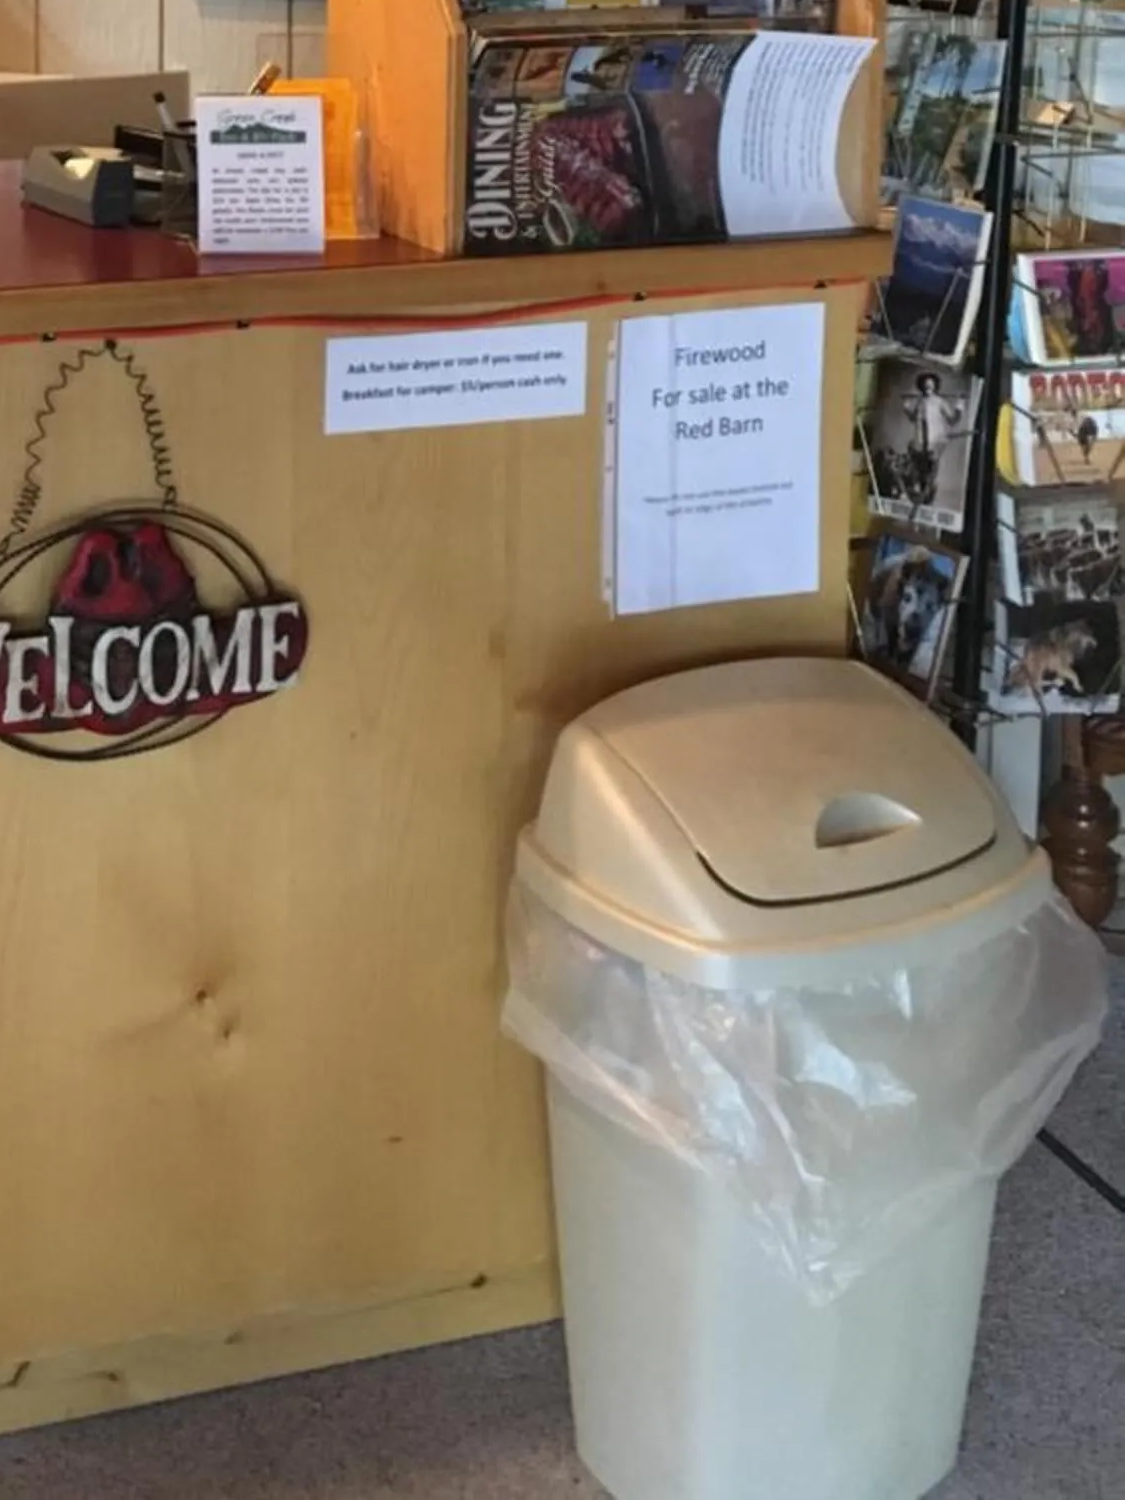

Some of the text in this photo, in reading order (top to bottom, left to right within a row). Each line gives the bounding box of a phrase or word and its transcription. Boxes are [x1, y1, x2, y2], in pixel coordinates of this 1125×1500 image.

[466, 102, 518, 240] DINING
[369, 360, 385, 373] for
[388, 359, 410, 372] hair
[674, 340, 766, 367] Firewood
[342, 386, 395, 401] Breakfast
[396, 384, 412, 397] for
[652, 377, 790, 409] For sale at the
[675, 415, 764, 442] Red Barn
